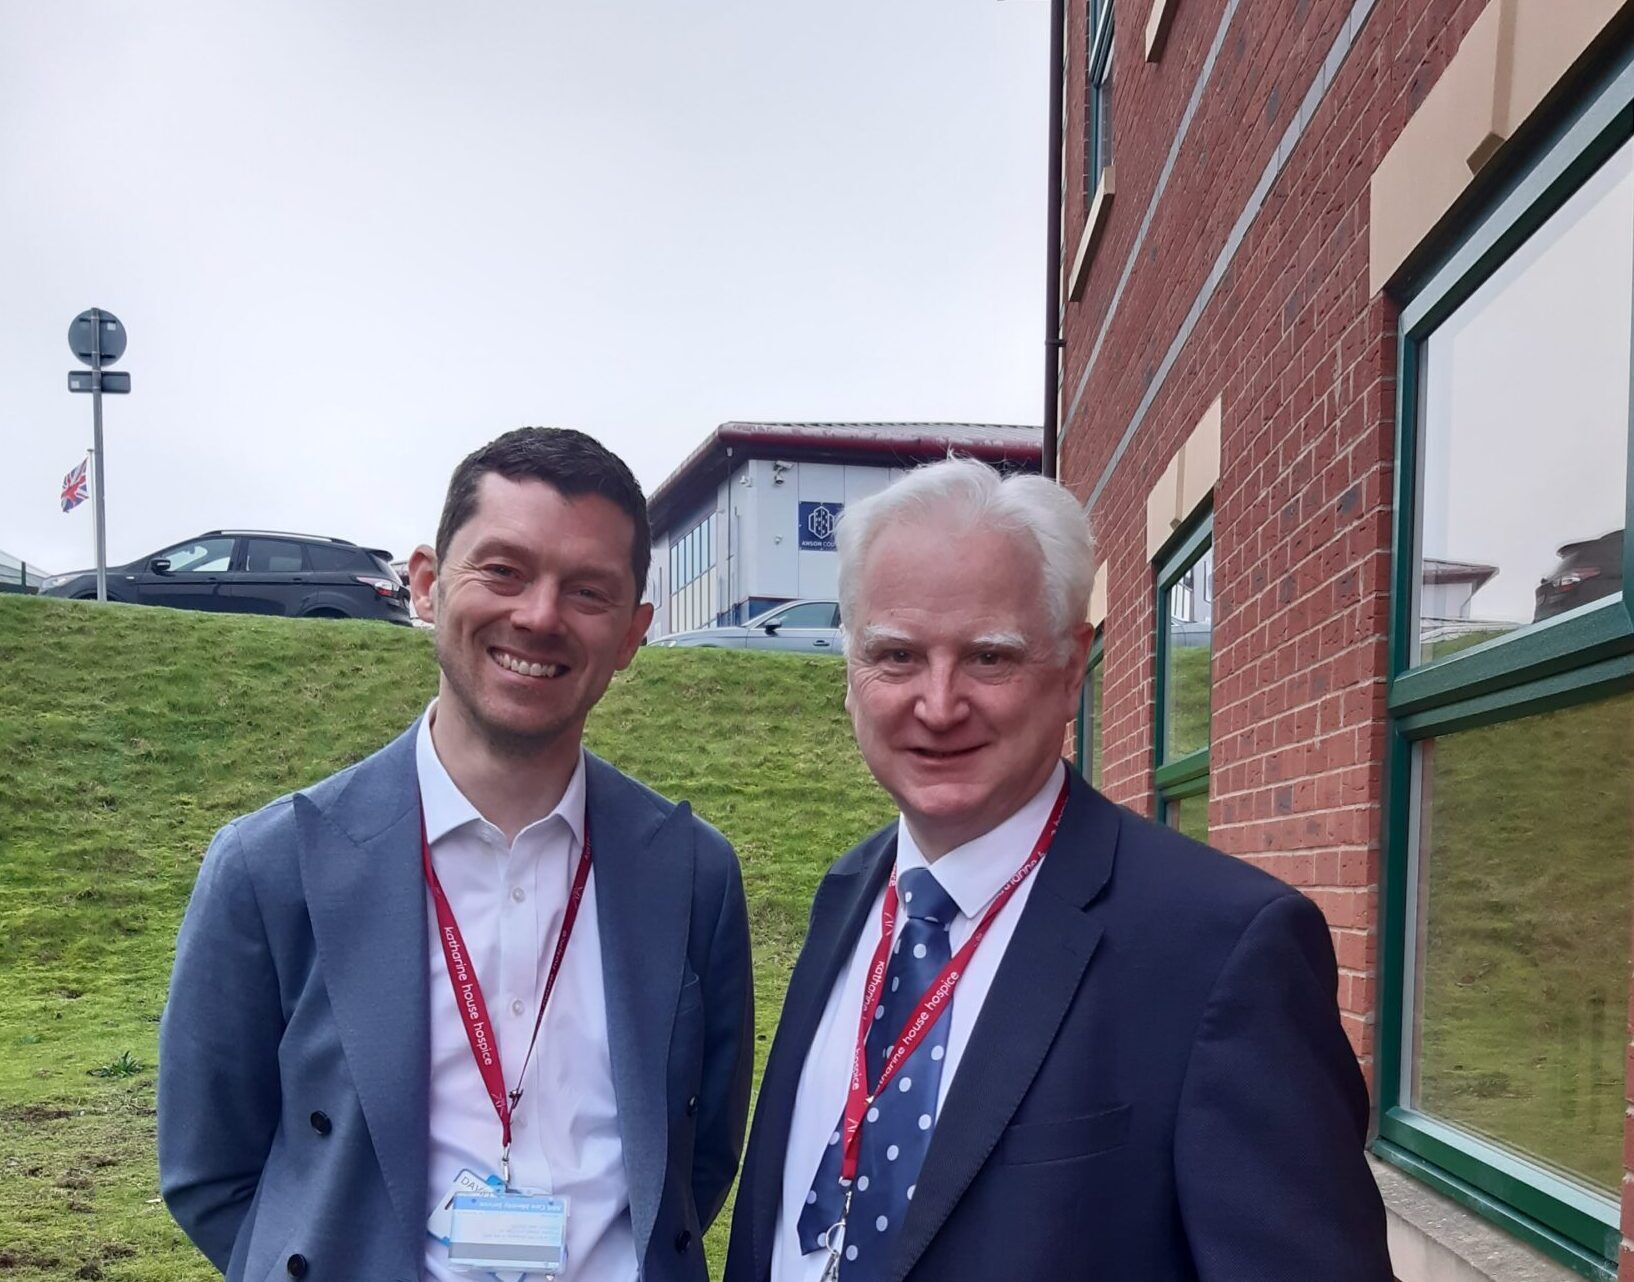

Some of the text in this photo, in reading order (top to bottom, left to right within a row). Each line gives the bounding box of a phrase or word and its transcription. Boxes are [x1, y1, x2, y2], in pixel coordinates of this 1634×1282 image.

[444, 926, 492, 1066] katharine house hospice
[902, 1010, 929, 1046] house
[925, 970, 960, 1014] hospice
